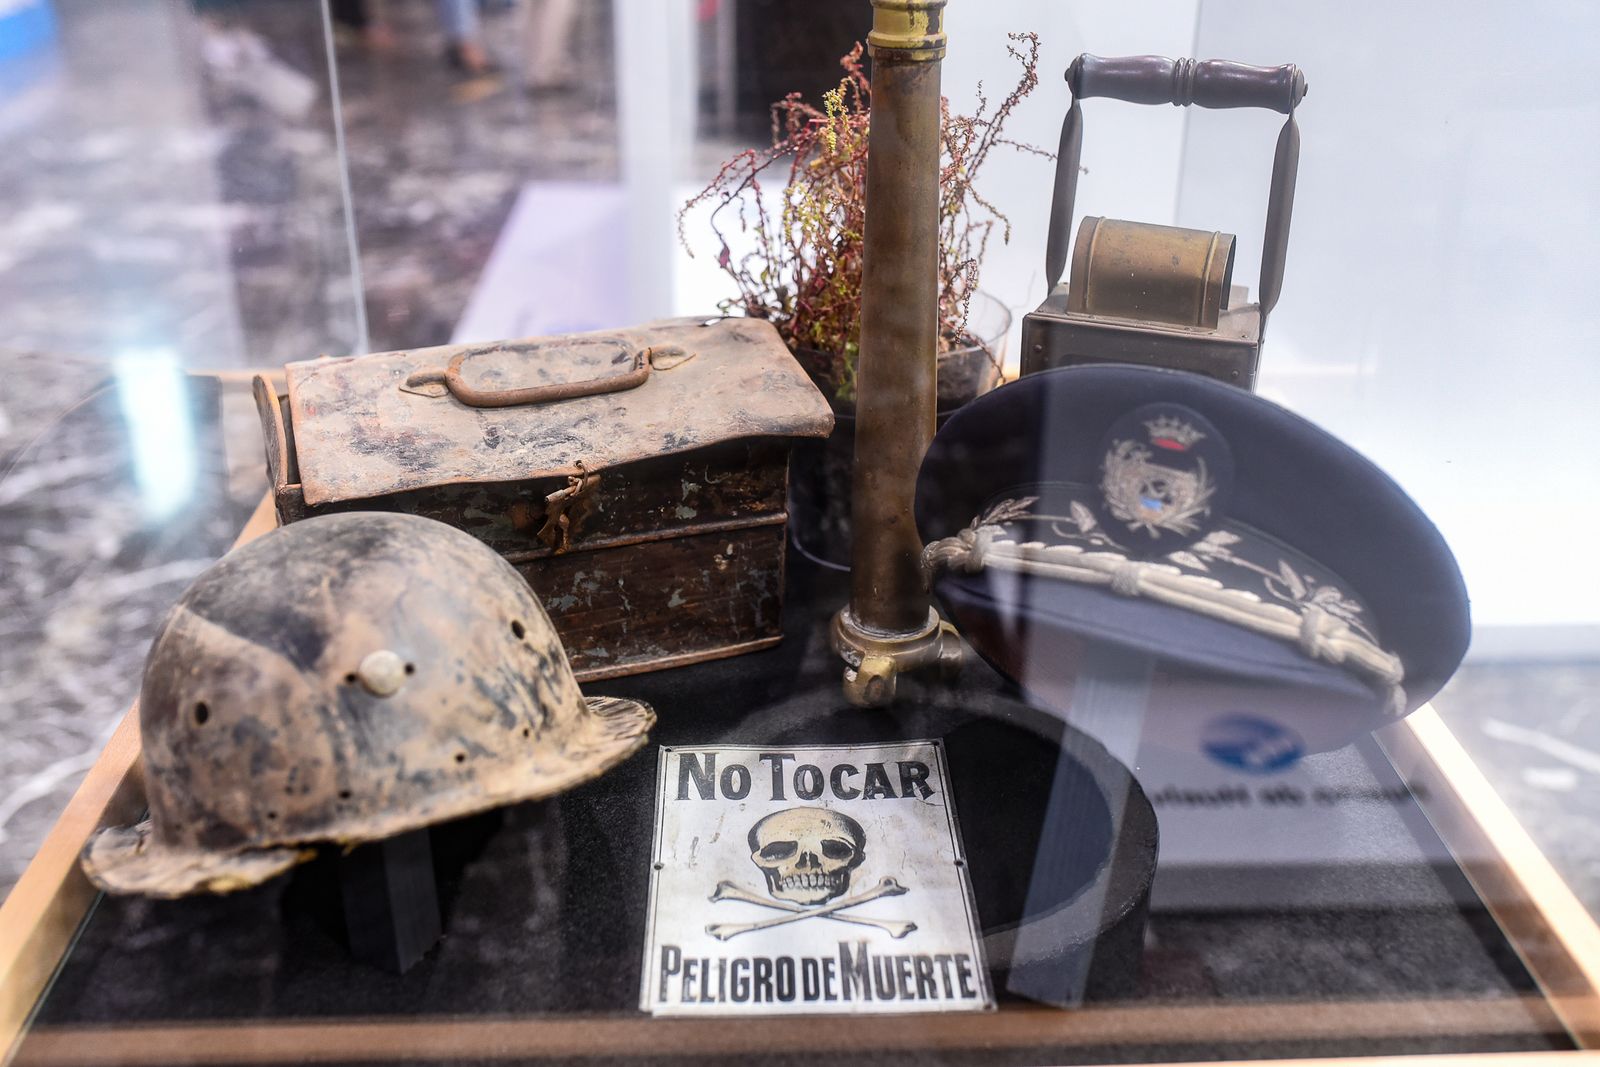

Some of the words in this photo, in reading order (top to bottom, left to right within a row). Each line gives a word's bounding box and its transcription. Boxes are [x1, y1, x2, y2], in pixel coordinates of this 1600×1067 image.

[677, 752, 752, 801] NO
[759, 753, 936, 801] TOCAR
[658, 945, 796, 1003] PELIGRO
[802, 957, 838, 1001] DE
[838, 941, 978, 1002] MUERTE
